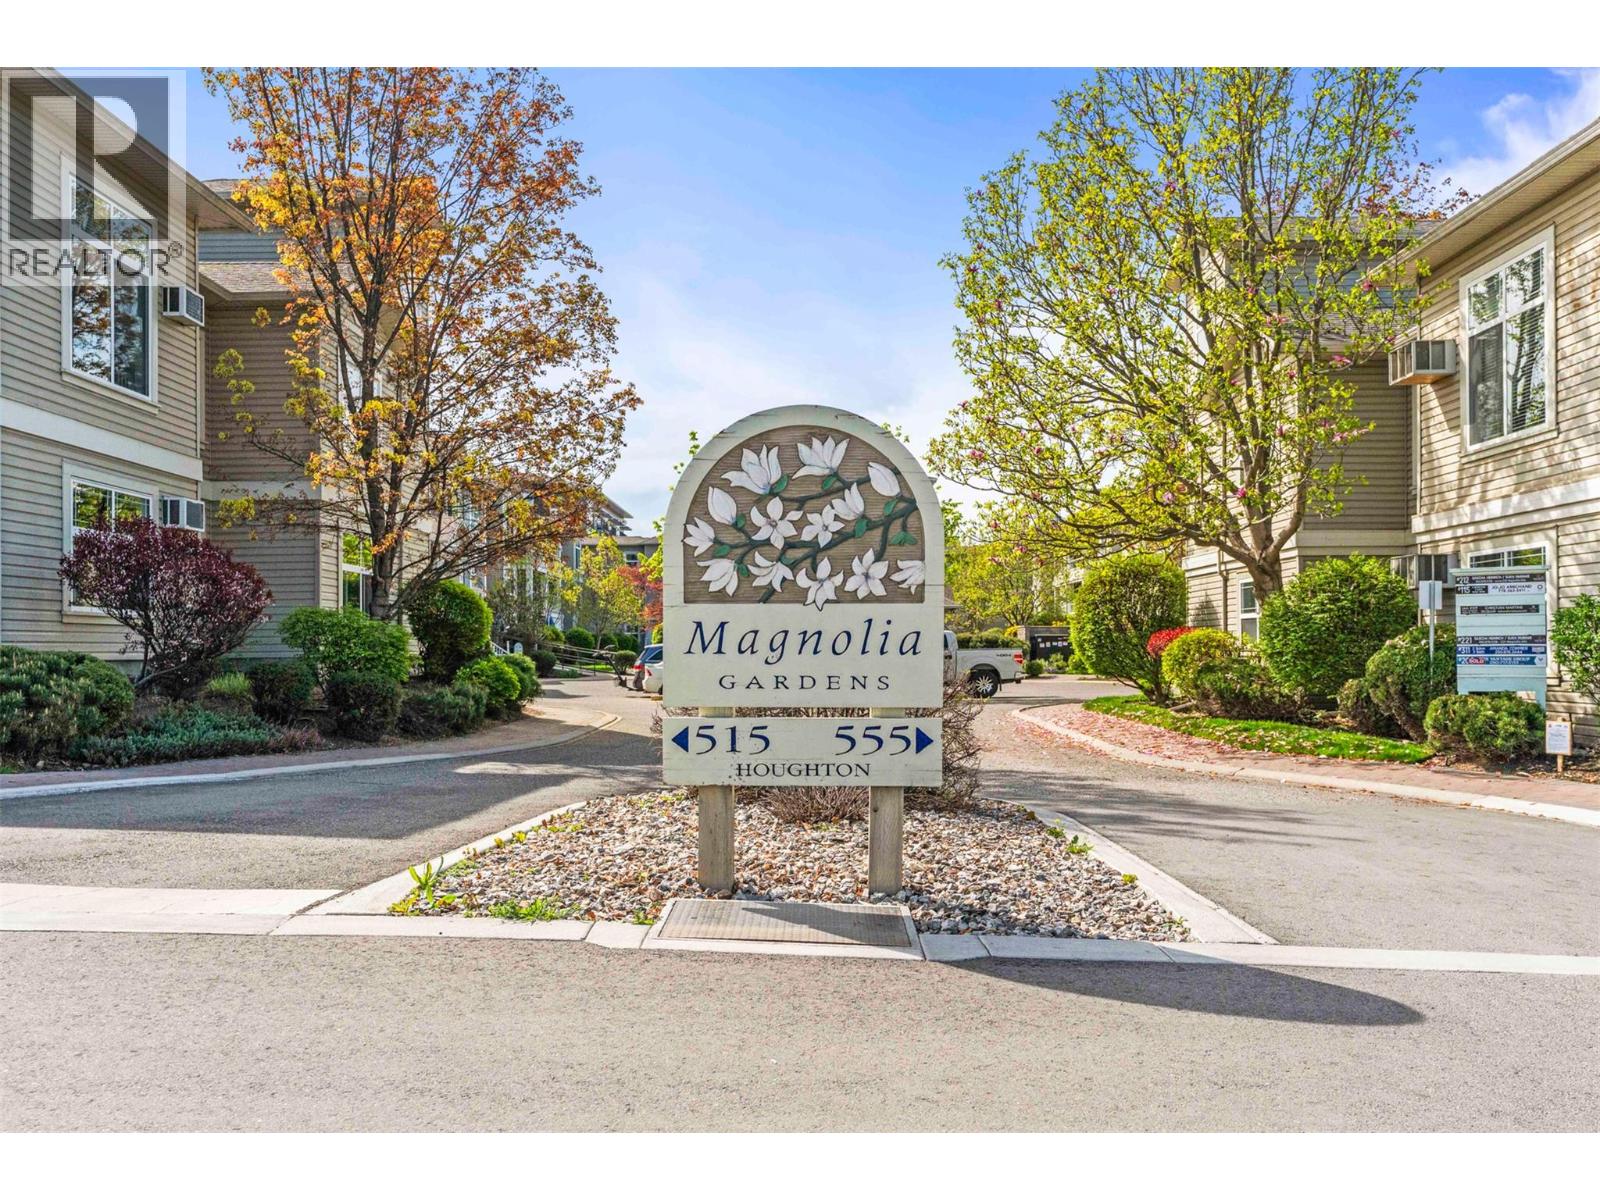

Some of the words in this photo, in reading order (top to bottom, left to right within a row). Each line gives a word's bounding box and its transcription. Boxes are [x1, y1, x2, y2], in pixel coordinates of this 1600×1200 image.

[683, 618, 922, 666] Magnolia
[718, 675, 890, 690] GARDENS
[695, 725, 771, 755] 515
[834, 725, 912, 756] 555
[735, 762, 871, 777] HOUGHTON
